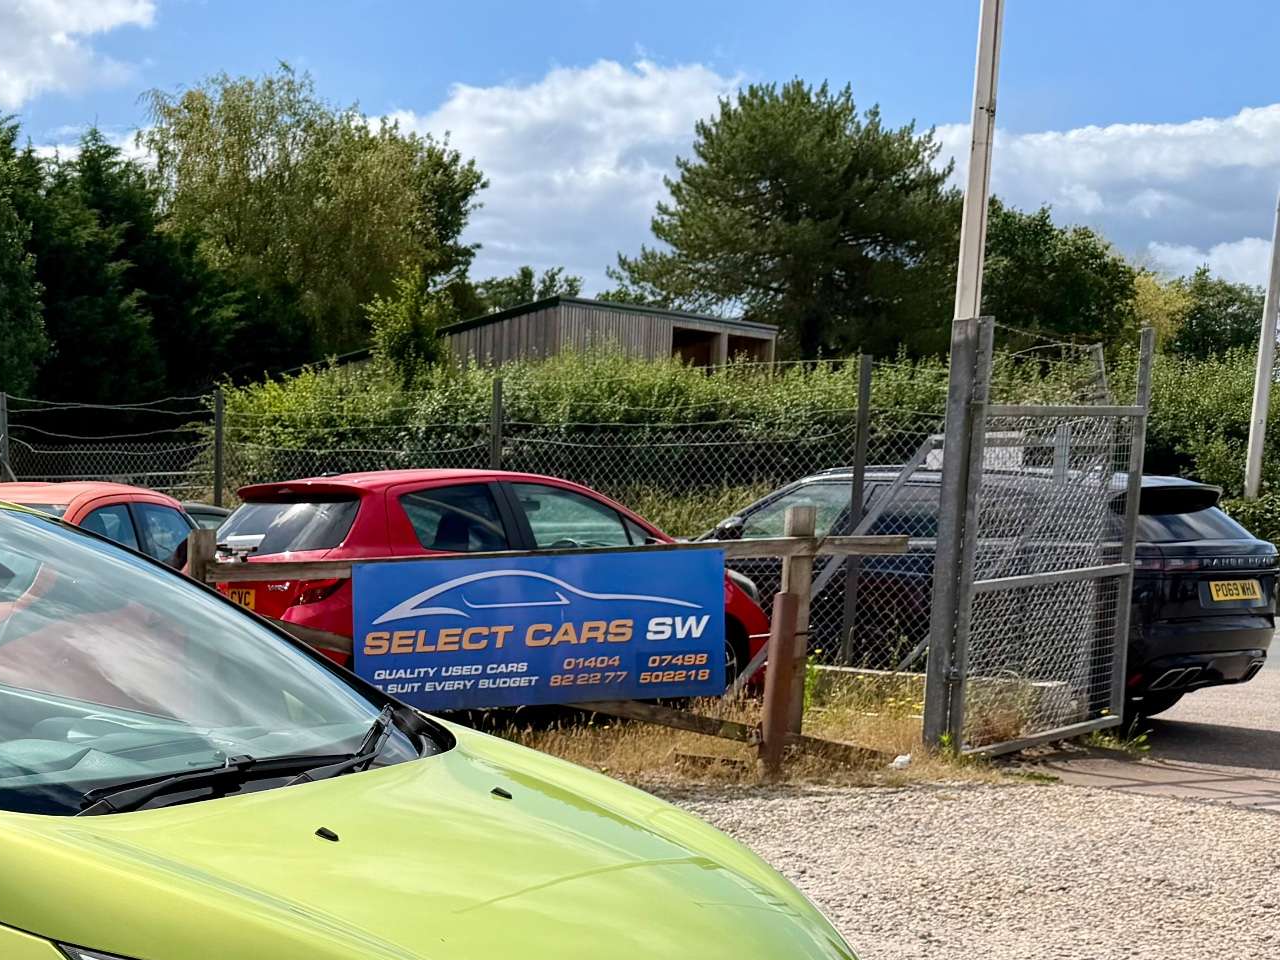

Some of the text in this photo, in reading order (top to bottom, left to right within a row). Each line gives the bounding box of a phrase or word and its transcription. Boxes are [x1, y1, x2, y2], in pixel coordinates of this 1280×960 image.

[364, 615, 711, 656] SELECT CARS SW
[374, 662, 528, 680] QUALITY USED CARS
[563, 655, 620, 670] 01404
[387, 682, 422, 694] SUIT
[424, 679, 475, 692] EVERY
[478, 676, 539, 688] BUDGET
